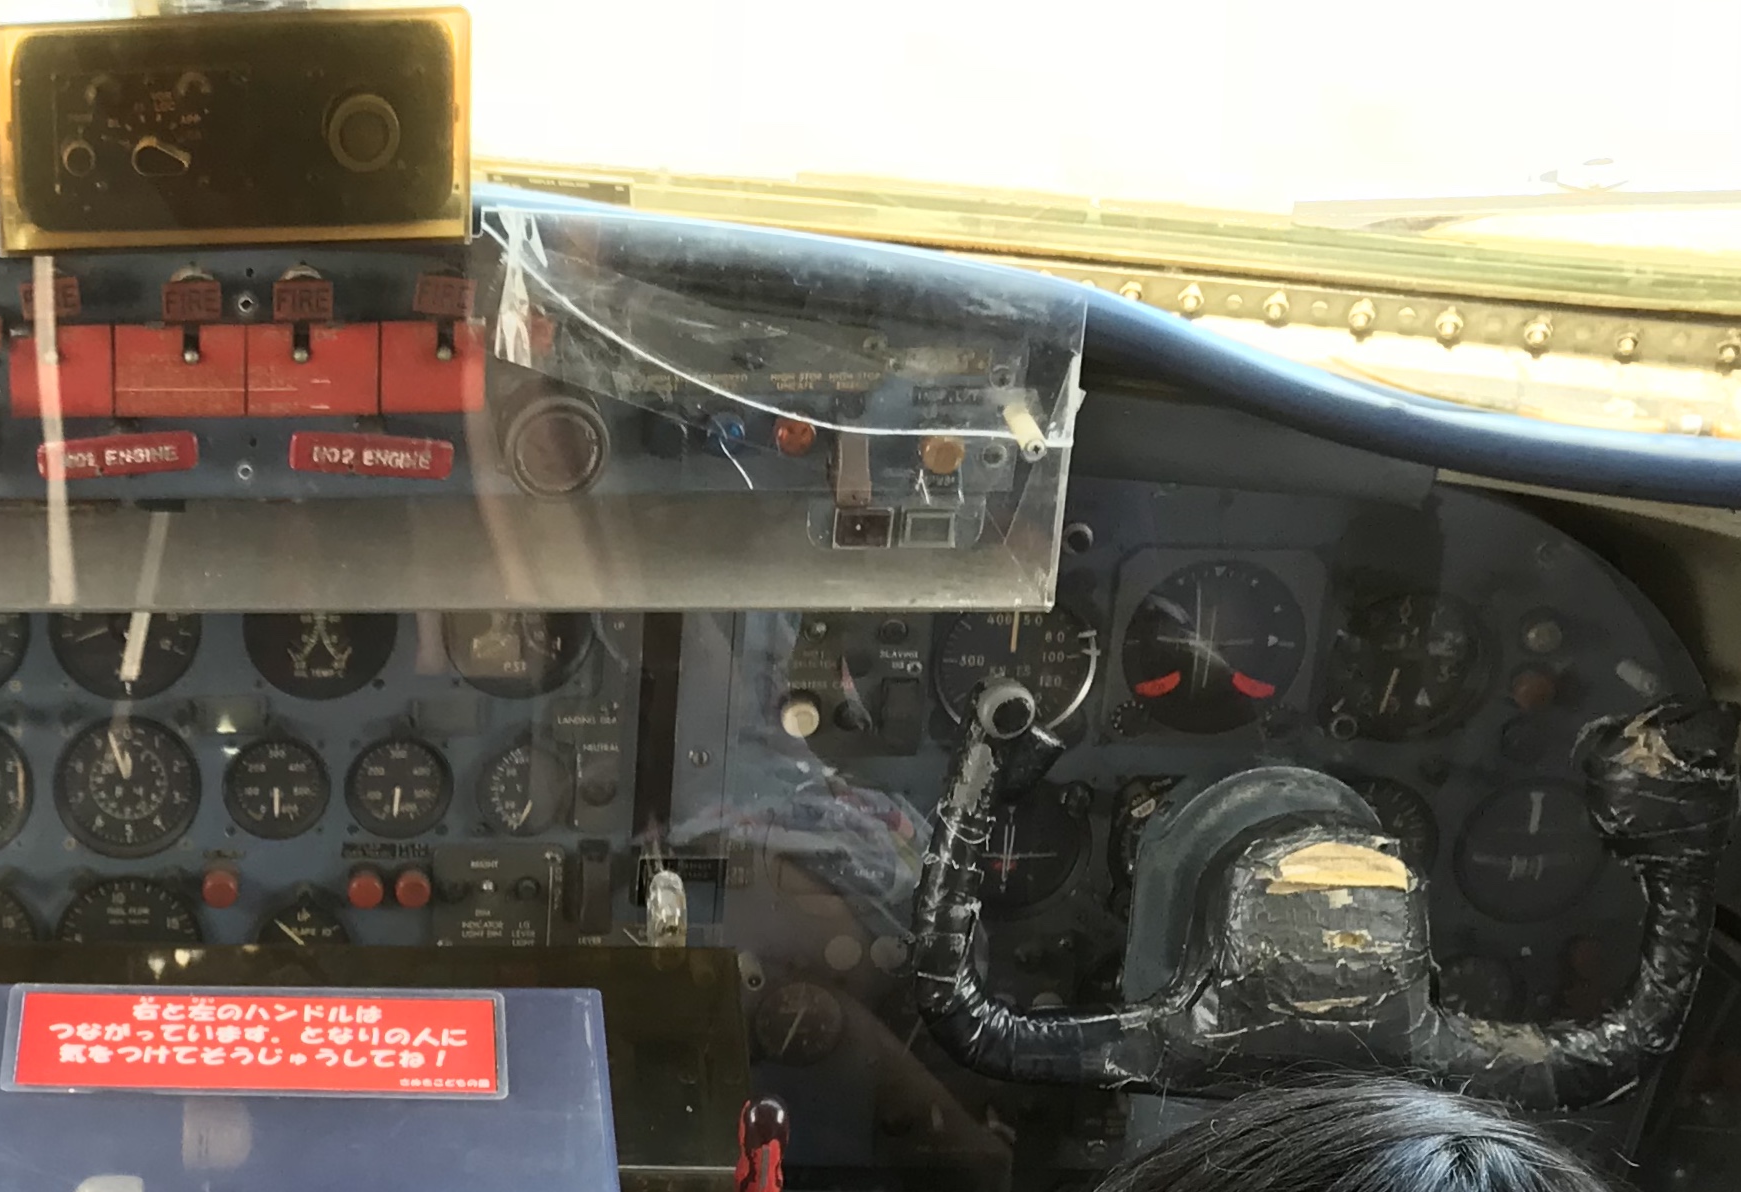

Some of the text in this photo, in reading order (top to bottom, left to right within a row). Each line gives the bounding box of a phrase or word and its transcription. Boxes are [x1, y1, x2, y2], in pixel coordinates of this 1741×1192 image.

[165, 288, 219, 314] FIRE
[275, 289, 329, 313] FIRE
[418, 280, 470, 310] FIRE
[106, 445, 179, 467] ENGINE
[362, 450, 432, 470] ENGINE
[131, 1001, 384, 1025] 右と左のハンドルは
[48, 1022, 468, 1048] つながっています。となりの人に
[58, 1043, 448, 1069] 気をつけてそうじゅうしてね！
